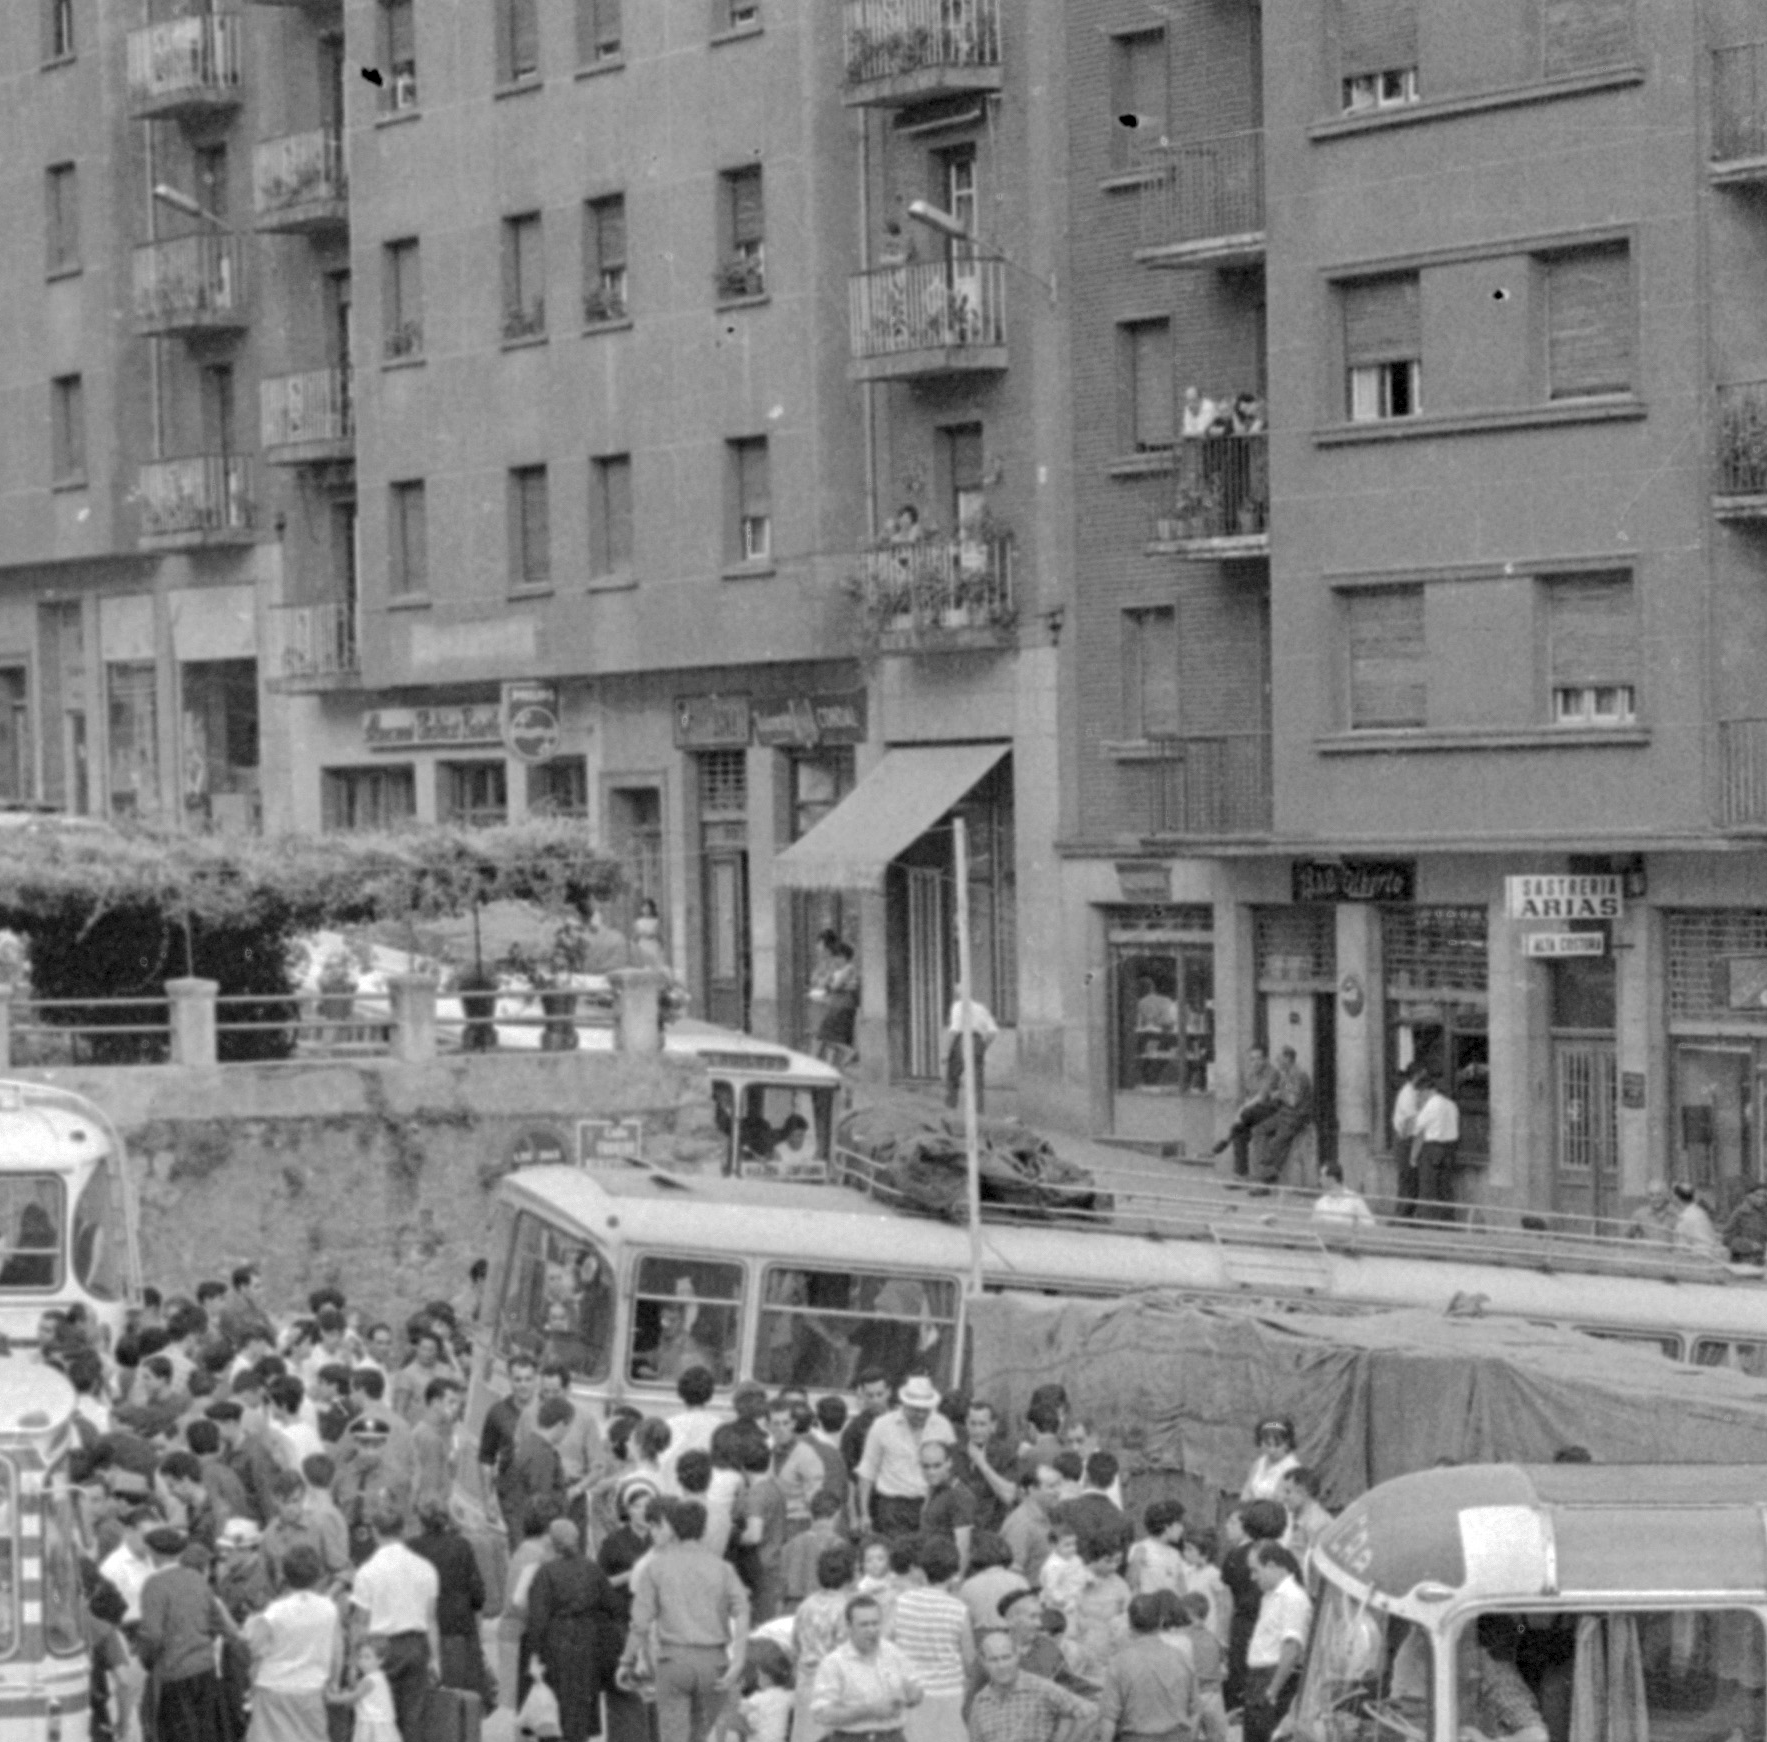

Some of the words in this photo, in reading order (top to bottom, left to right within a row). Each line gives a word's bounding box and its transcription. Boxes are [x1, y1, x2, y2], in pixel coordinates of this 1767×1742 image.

[1521, 879, 1617, 897] SASTRERIA
[1520, 899, 1619, 917] ARIAS
[1533, 937, 1556, 953] ALTA
